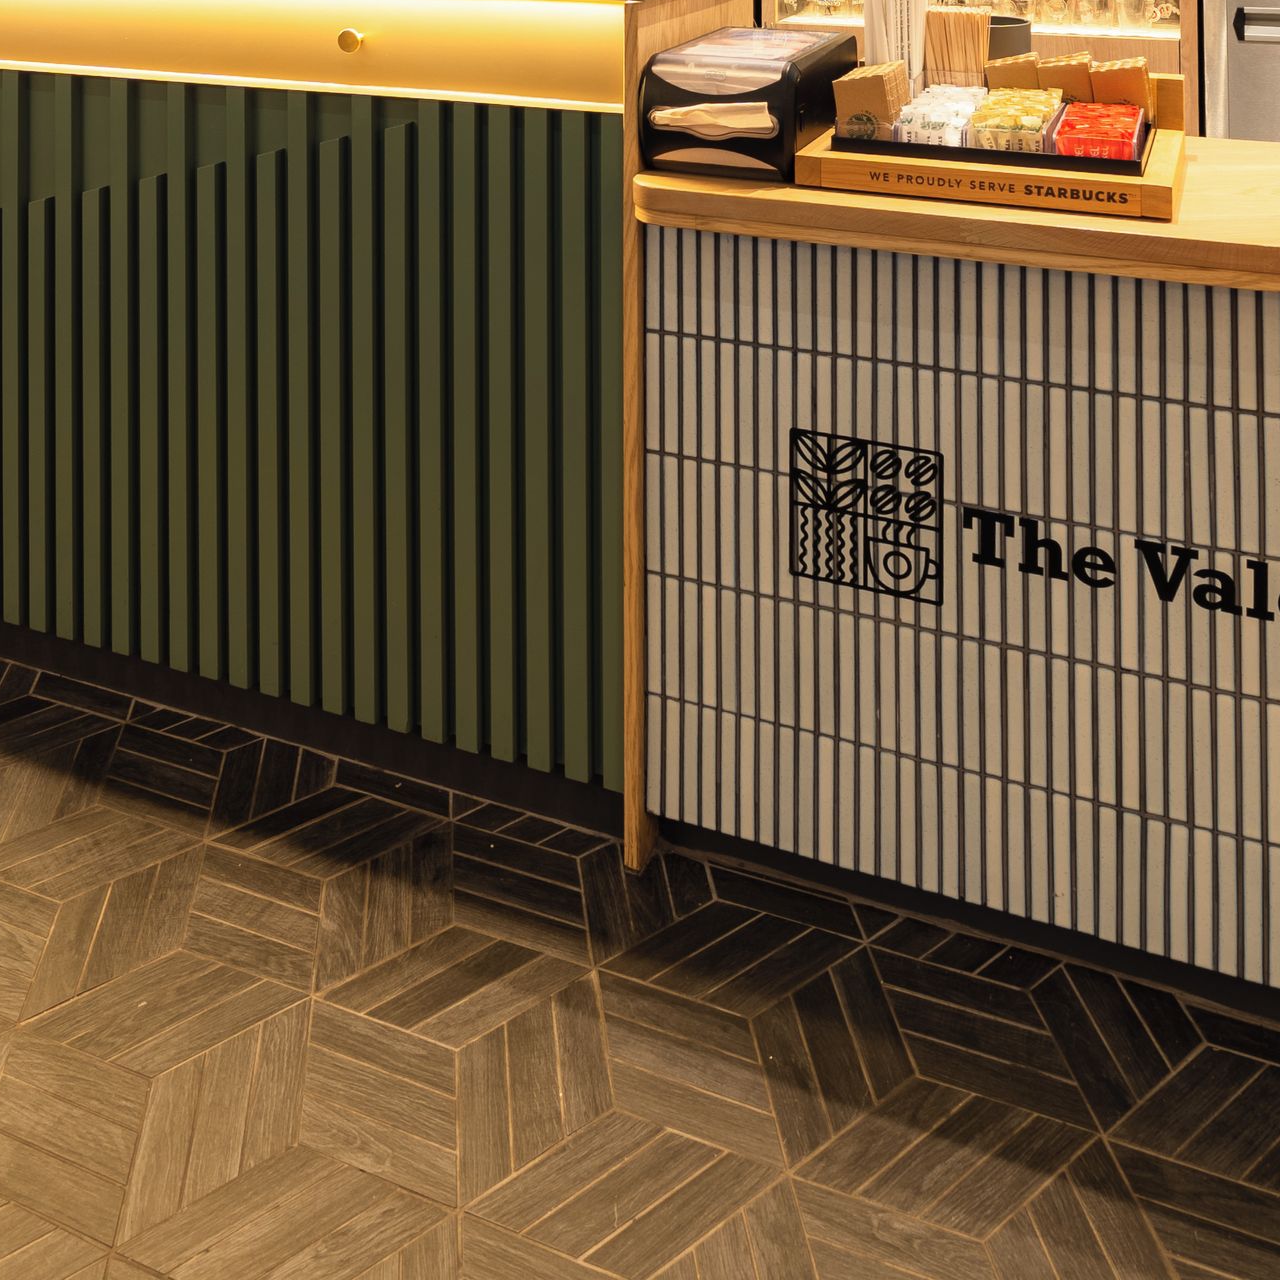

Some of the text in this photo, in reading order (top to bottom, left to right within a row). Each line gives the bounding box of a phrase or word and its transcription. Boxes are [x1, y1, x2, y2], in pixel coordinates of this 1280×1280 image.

[869, 170, 1129, 204] WE PROUDLY SERVE STARBUCKS
[963, 507, 1116, 588] The
